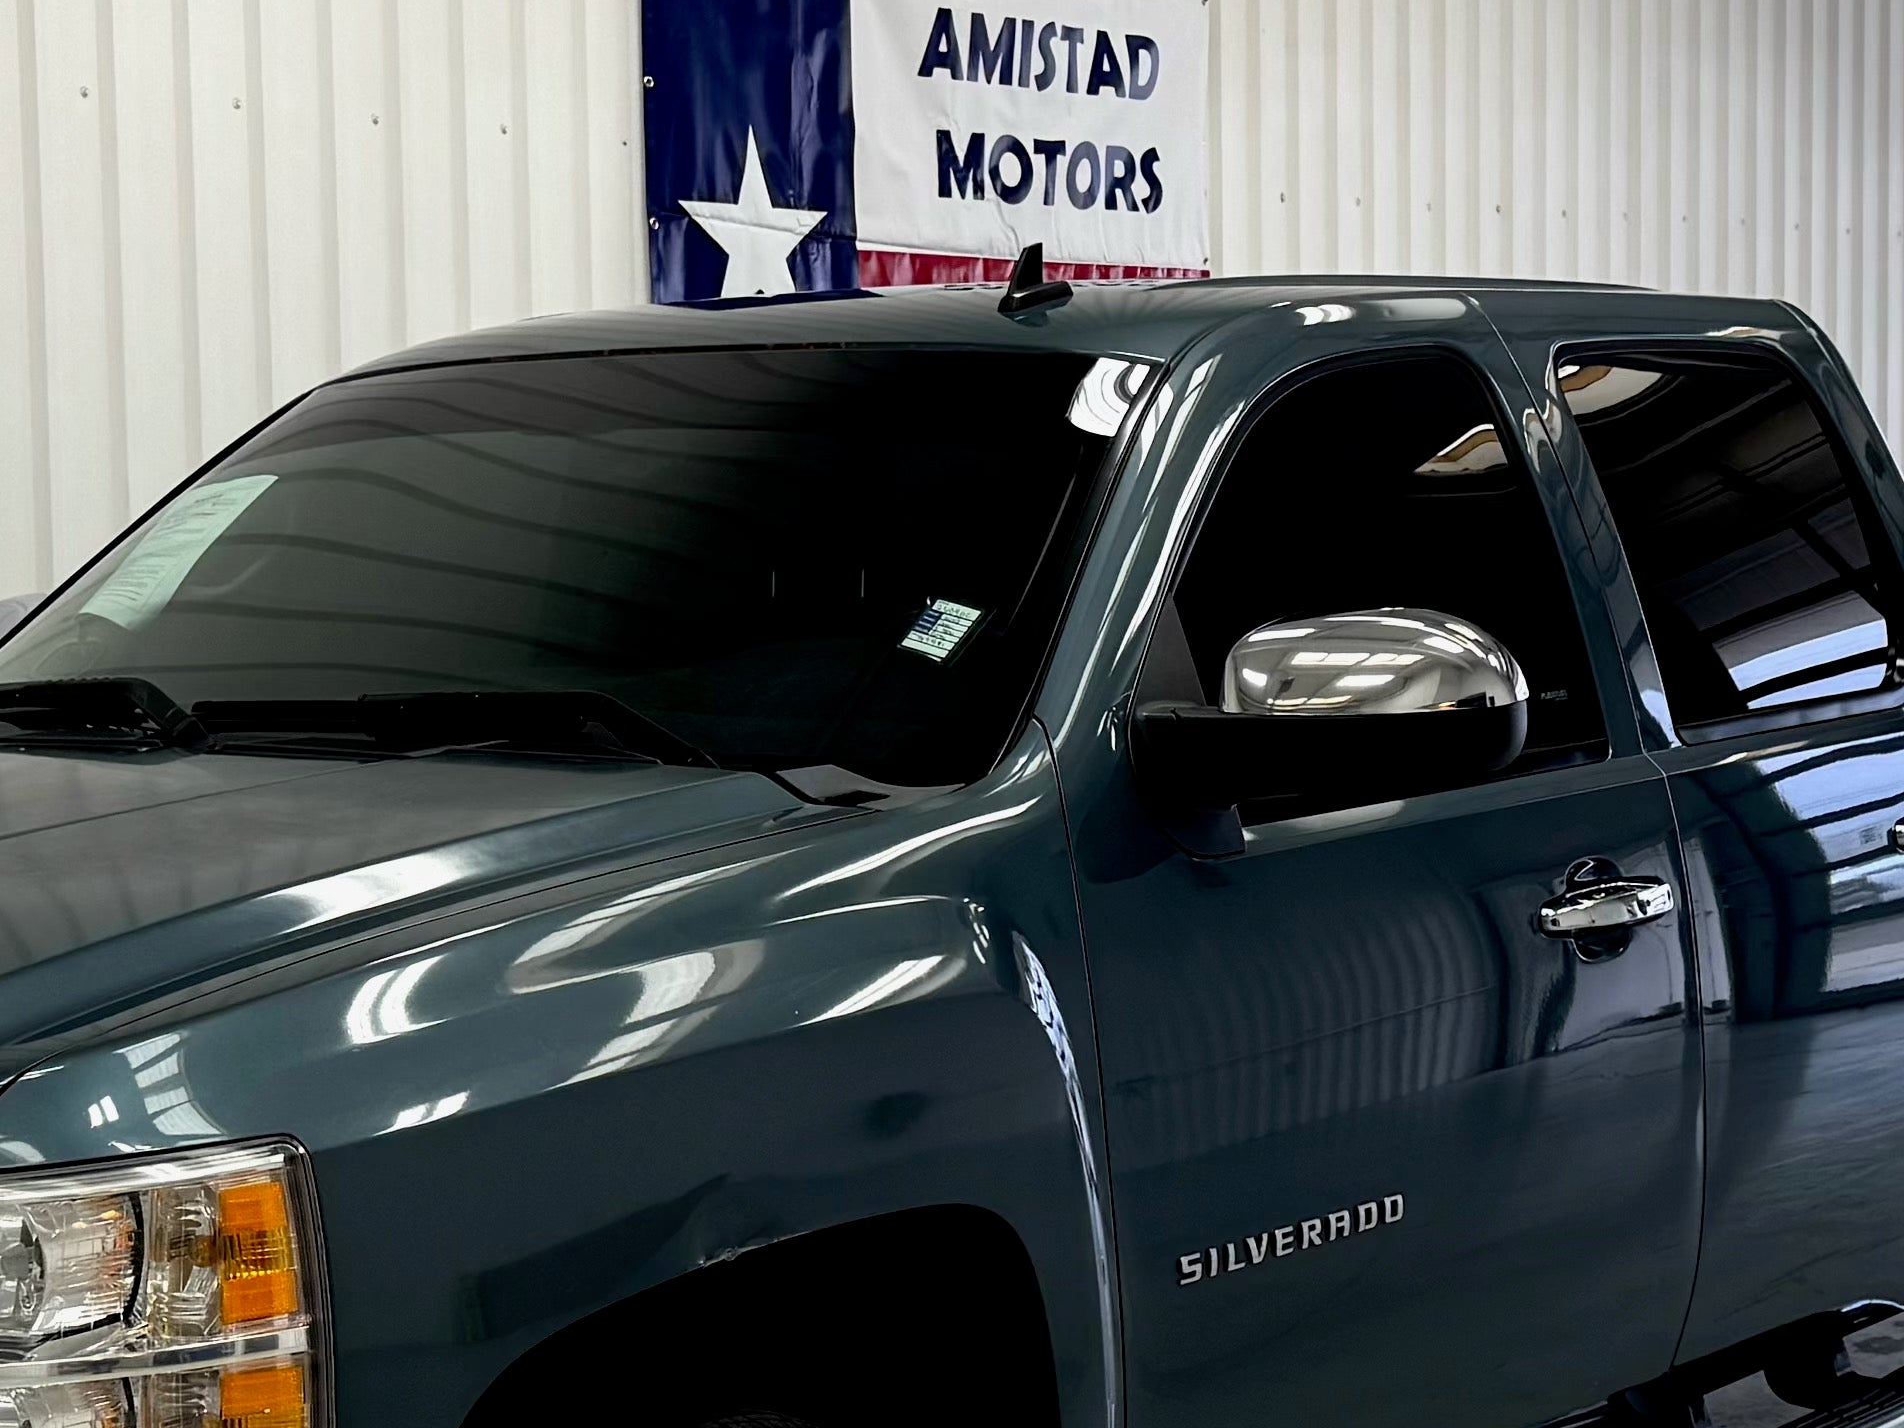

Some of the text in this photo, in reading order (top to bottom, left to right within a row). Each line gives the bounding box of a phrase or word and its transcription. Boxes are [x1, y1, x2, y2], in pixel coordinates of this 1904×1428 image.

[917, 7, 1160, 100] AMISTAD
[936, 129, 1163, 214] MOTORS
[1178, 1193, 1405, 1285] SILVERADO
